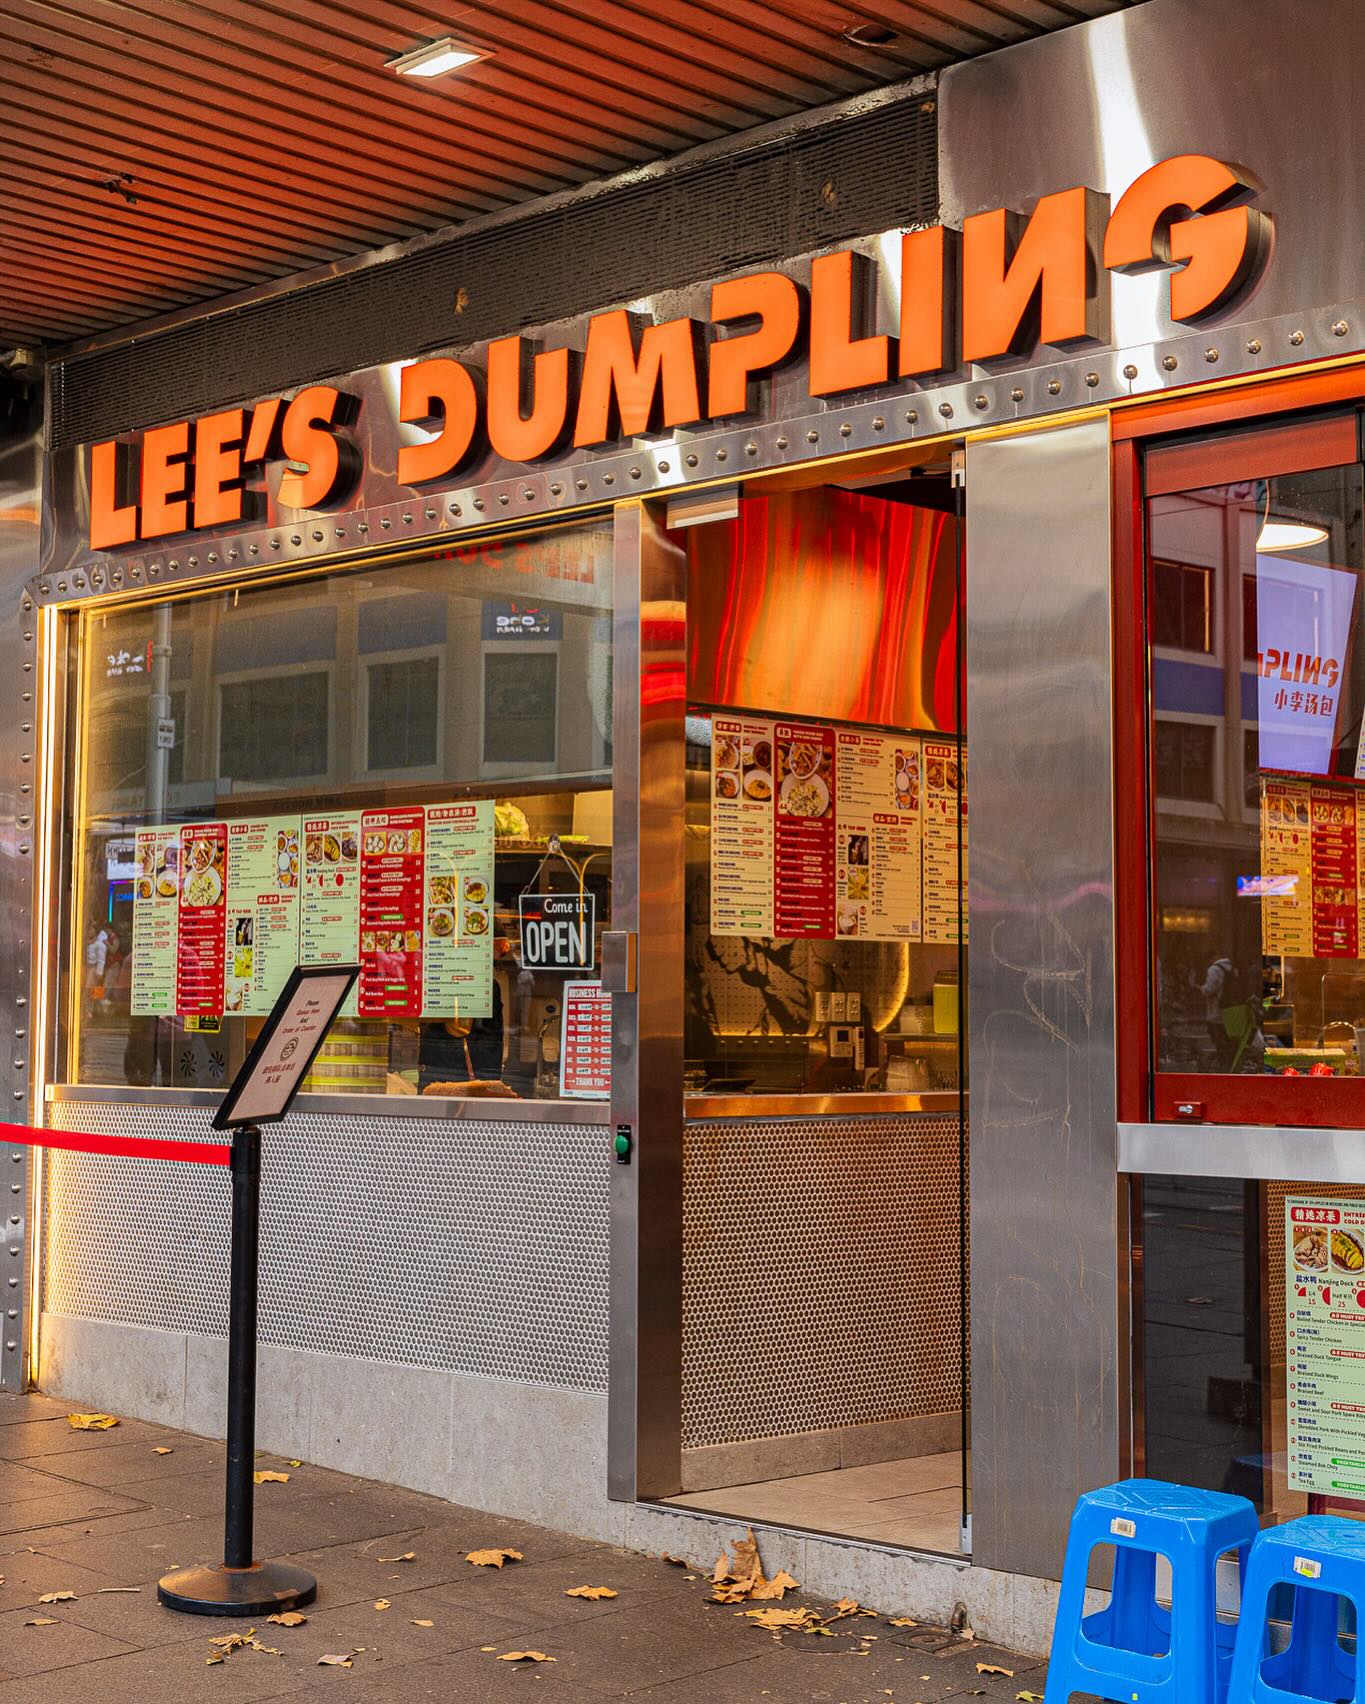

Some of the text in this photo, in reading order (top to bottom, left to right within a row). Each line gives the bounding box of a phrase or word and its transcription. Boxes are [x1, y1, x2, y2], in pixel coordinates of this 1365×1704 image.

[90, 154, 1262, 551] LEE'S DUMPLING
[1274, 688, 1333, 716] 小李汤包
[544, 898, 588, 913] Come in
[526, 921, 587, 963] OPEN
[568, 988, 596, 998] BUSINESS
[576, 1077, 605, 1086] THANK YOU
[1318, 1278, 1340, 1286] Nanjing
[1337, 1300, 1346, 1308] 25
[1326, 1463, 1338, 1471] Choy
